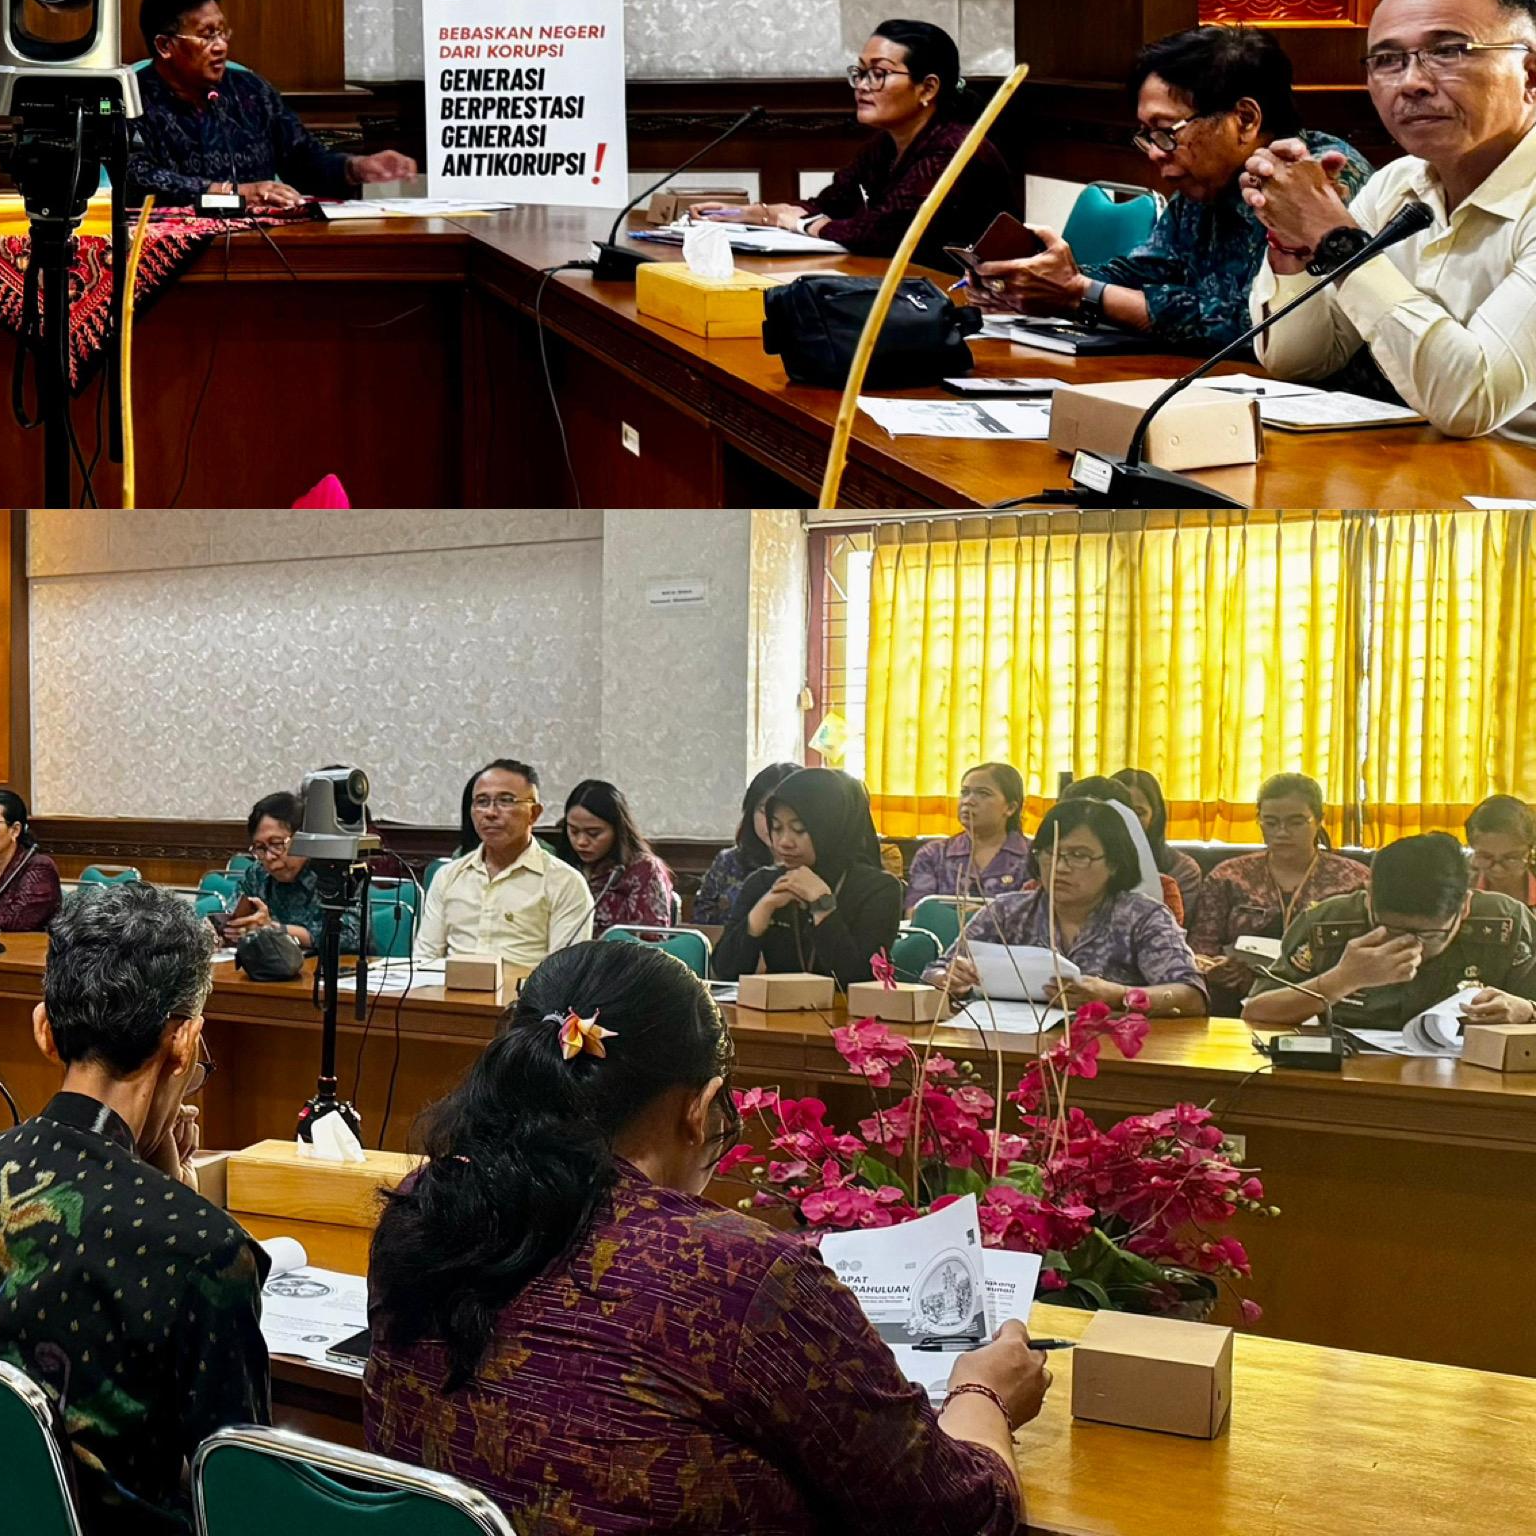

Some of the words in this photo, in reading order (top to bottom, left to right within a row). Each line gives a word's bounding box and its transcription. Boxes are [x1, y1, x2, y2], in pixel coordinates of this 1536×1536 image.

[439, 26, 533, 41] BEBASKAN
[539, 25, 606, 39] NEGERI
[439, 45, 481, 59] DARI
[487, 44, 565, 59] KORUPSI
[440, 68, 546, 92] GENERASI
[440, 95, 585, 120] BERPRESTASI
[441, 124, 547, 148] GENERASI
[839, 1276, 869, 1284] APAT
[852, 1285, 910, 1293] DAHULUAN
